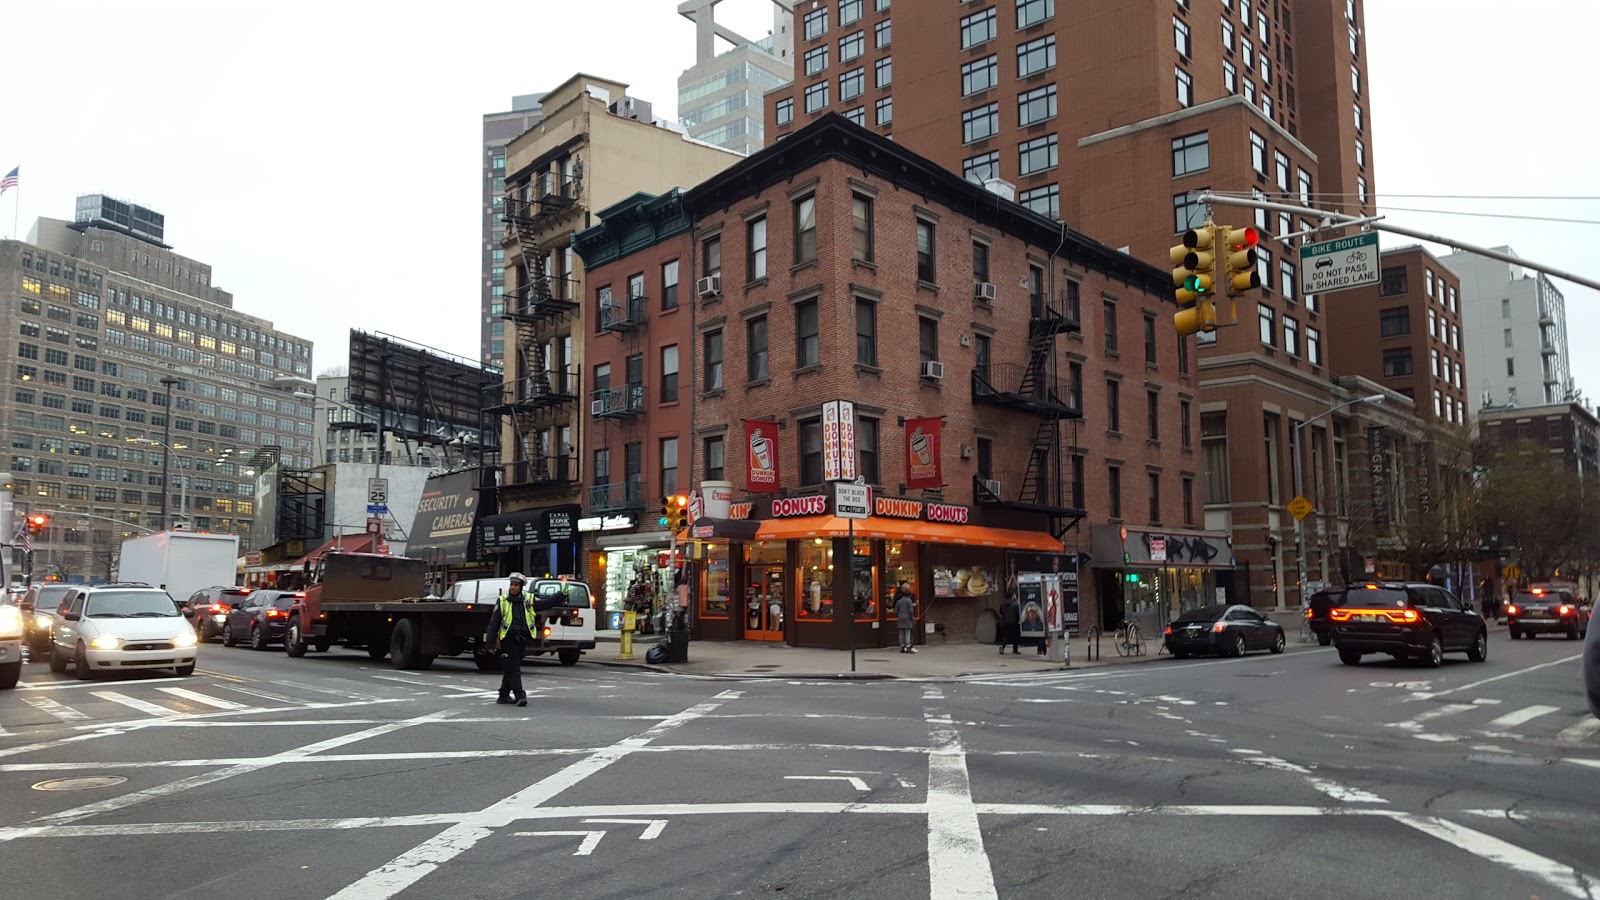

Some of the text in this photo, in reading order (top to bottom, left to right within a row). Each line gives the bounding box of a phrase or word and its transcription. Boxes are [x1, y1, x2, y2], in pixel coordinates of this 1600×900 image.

[1312, 236, 1365, 255] BIKE ROUTE
[1305, 271, 1376, 291] IN SHARED LANE
[1312, 263, 1367, 281] DO NOT PASS
[824, 423, 832, 478] DUNKIN
[831, 422, 839, 477] DONUTS
[840, 422, 848, 477] DUNKIN
[370, 491, 386, 501] 25
[418, 494, 460, 513] SECURITY
[772, 495, 826, 516] DONUTS
[876, 497, 968, 523] DUNKIN' DONUTS
[432, 512, 474, 530] CAMERAS
